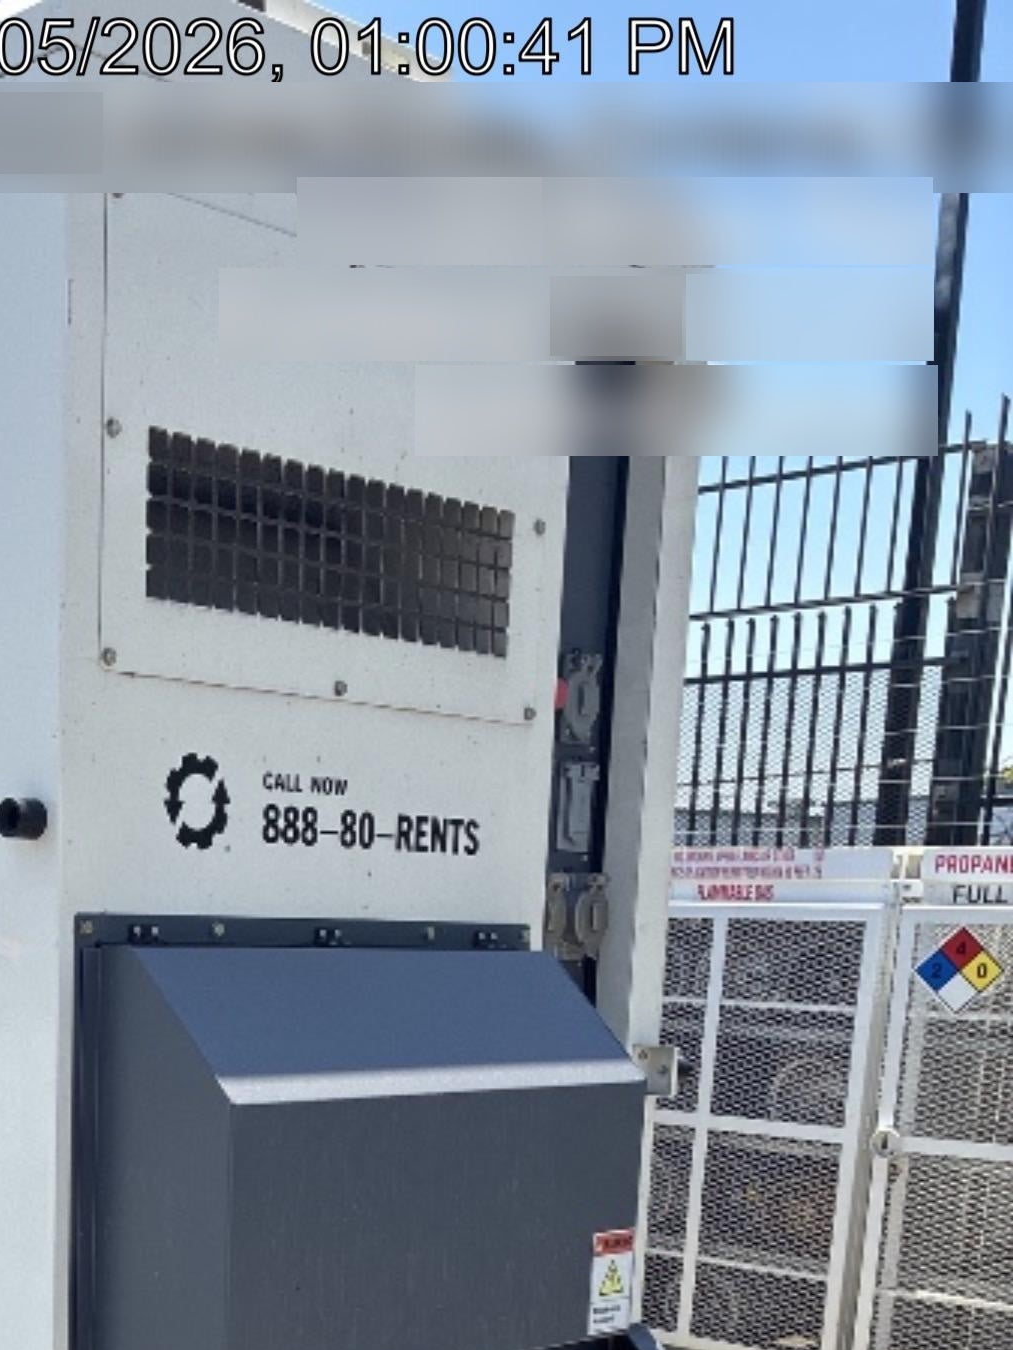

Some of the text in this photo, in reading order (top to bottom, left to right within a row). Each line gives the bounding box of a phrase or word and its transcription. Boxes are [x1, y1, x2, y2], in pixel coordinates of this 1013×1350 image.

[262, 771, 348, 796] CALL NOW
[262, 803, 481, 856] 888-80-RENTS
[953, 884, 1008, 904] FULL
[955, 941, 967, 956] 4
[931, 962, 943, 979] 2
[977, 962, 988, 979] 0
